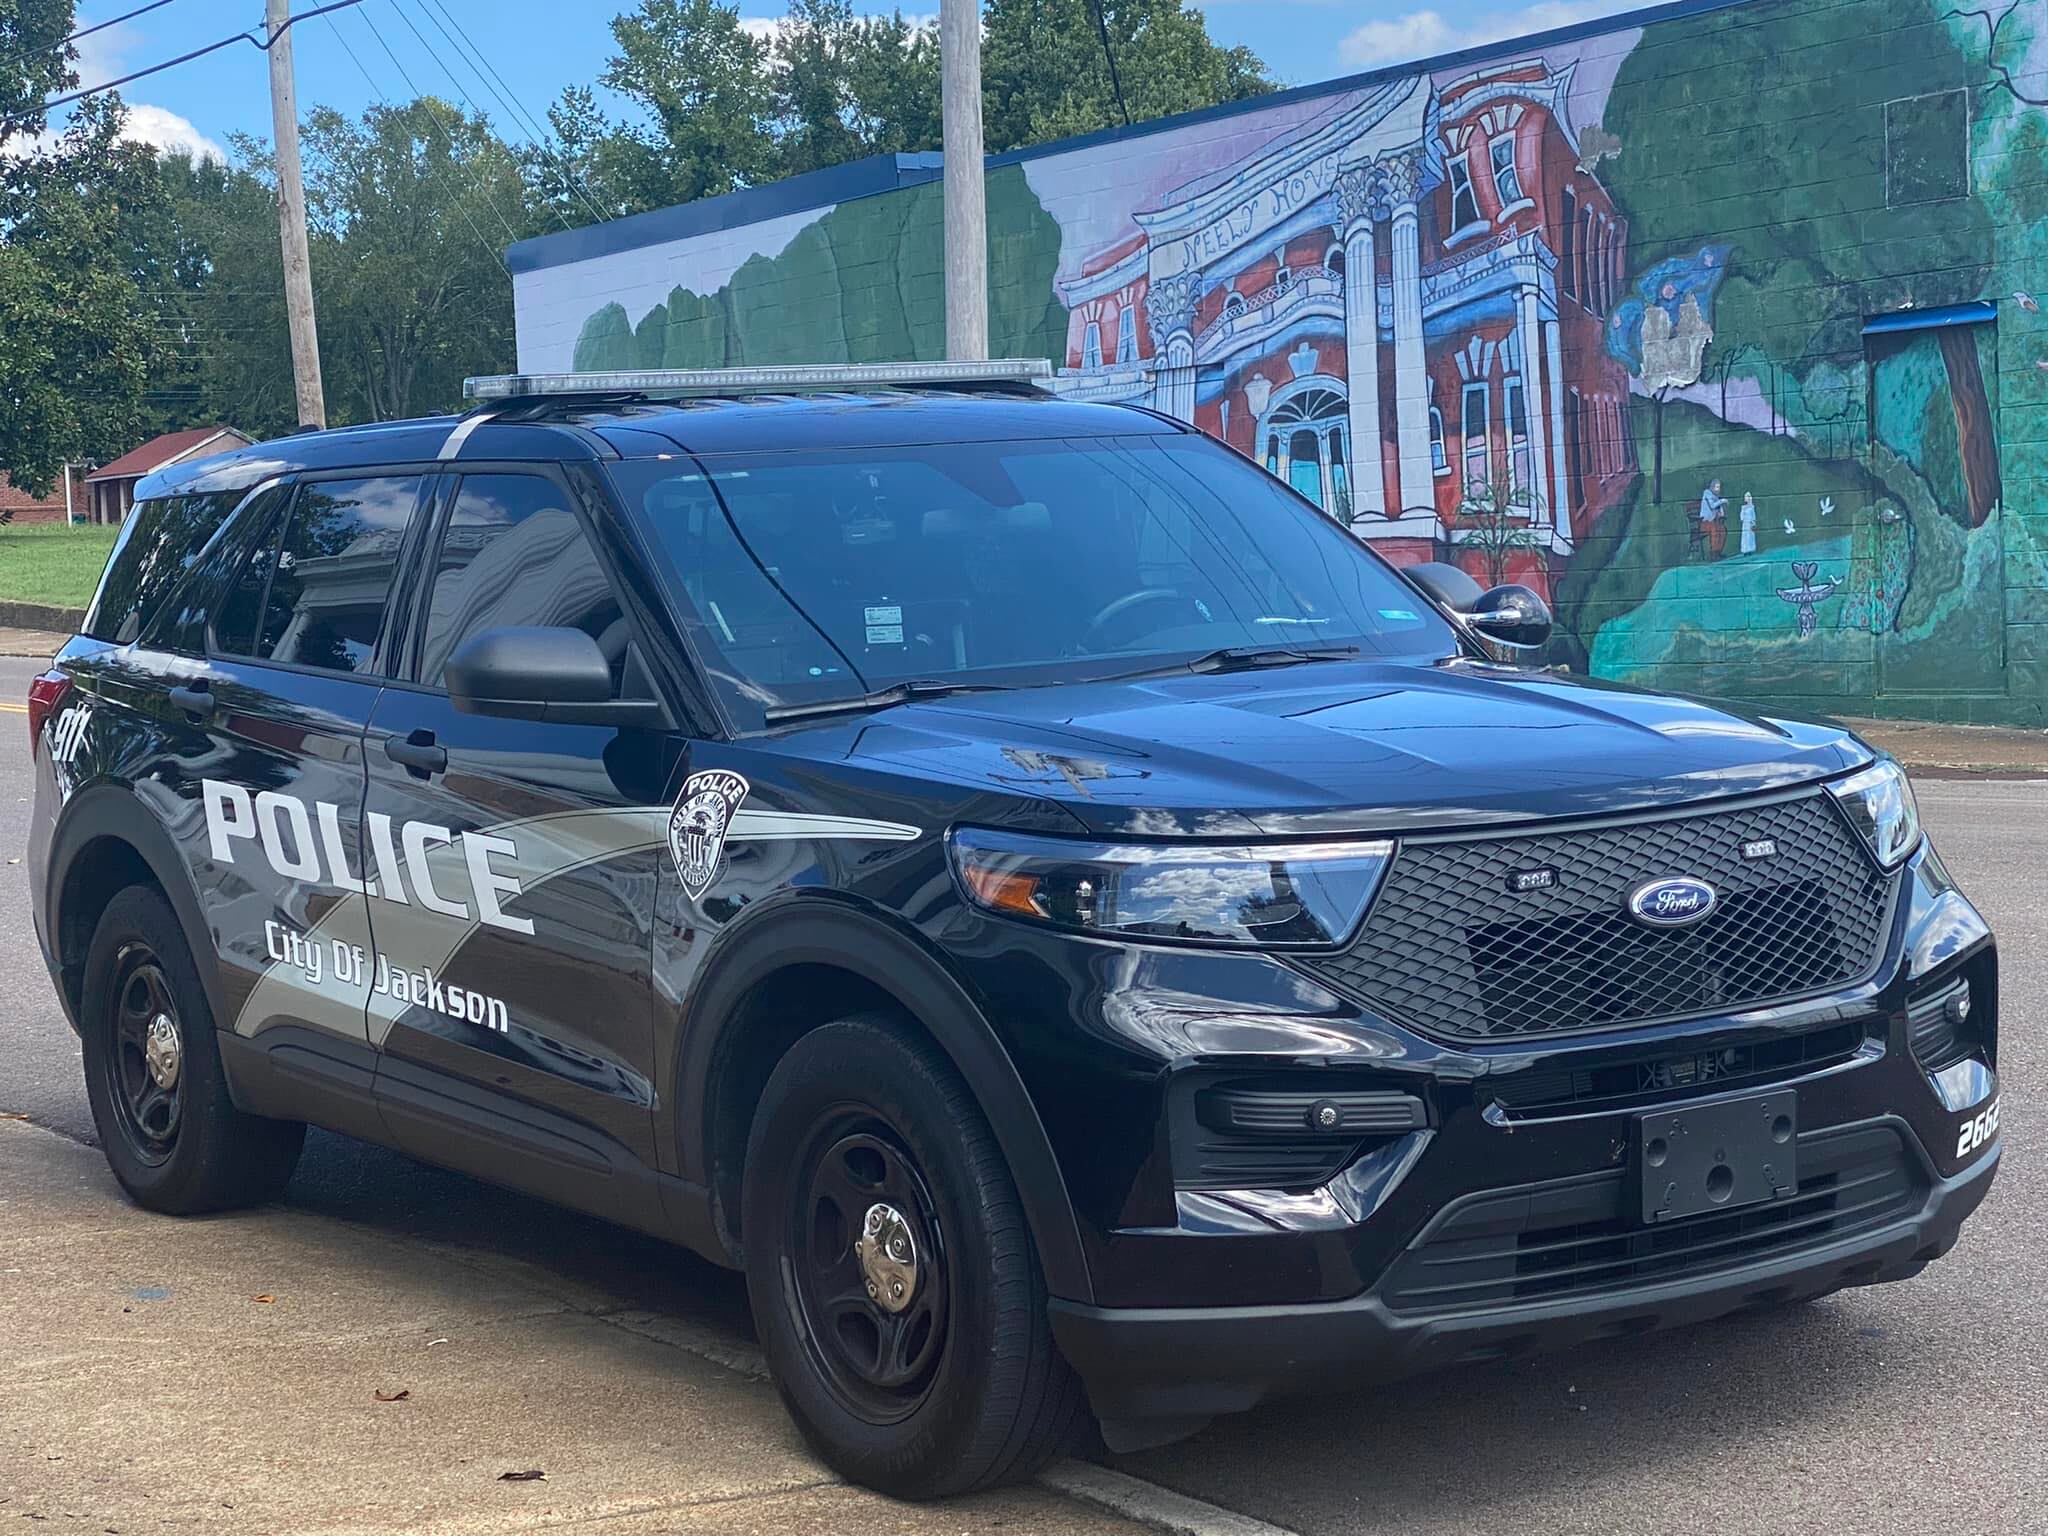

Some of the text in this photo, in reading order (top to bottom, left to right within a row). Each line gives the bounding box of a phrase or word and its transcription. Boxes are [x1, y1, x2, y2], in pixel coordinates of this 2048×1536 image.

[1182, 199, 1259, 268] NEELY
[672, 793, 725, 838] CITY OF JACKSON
[687, 774, 745, 804] POLICE
[202, 778, 536, 936] POLICE
[1655, 888, 1700, 913] Ford
[264, 919, 510, 1033] City Of Jackson
